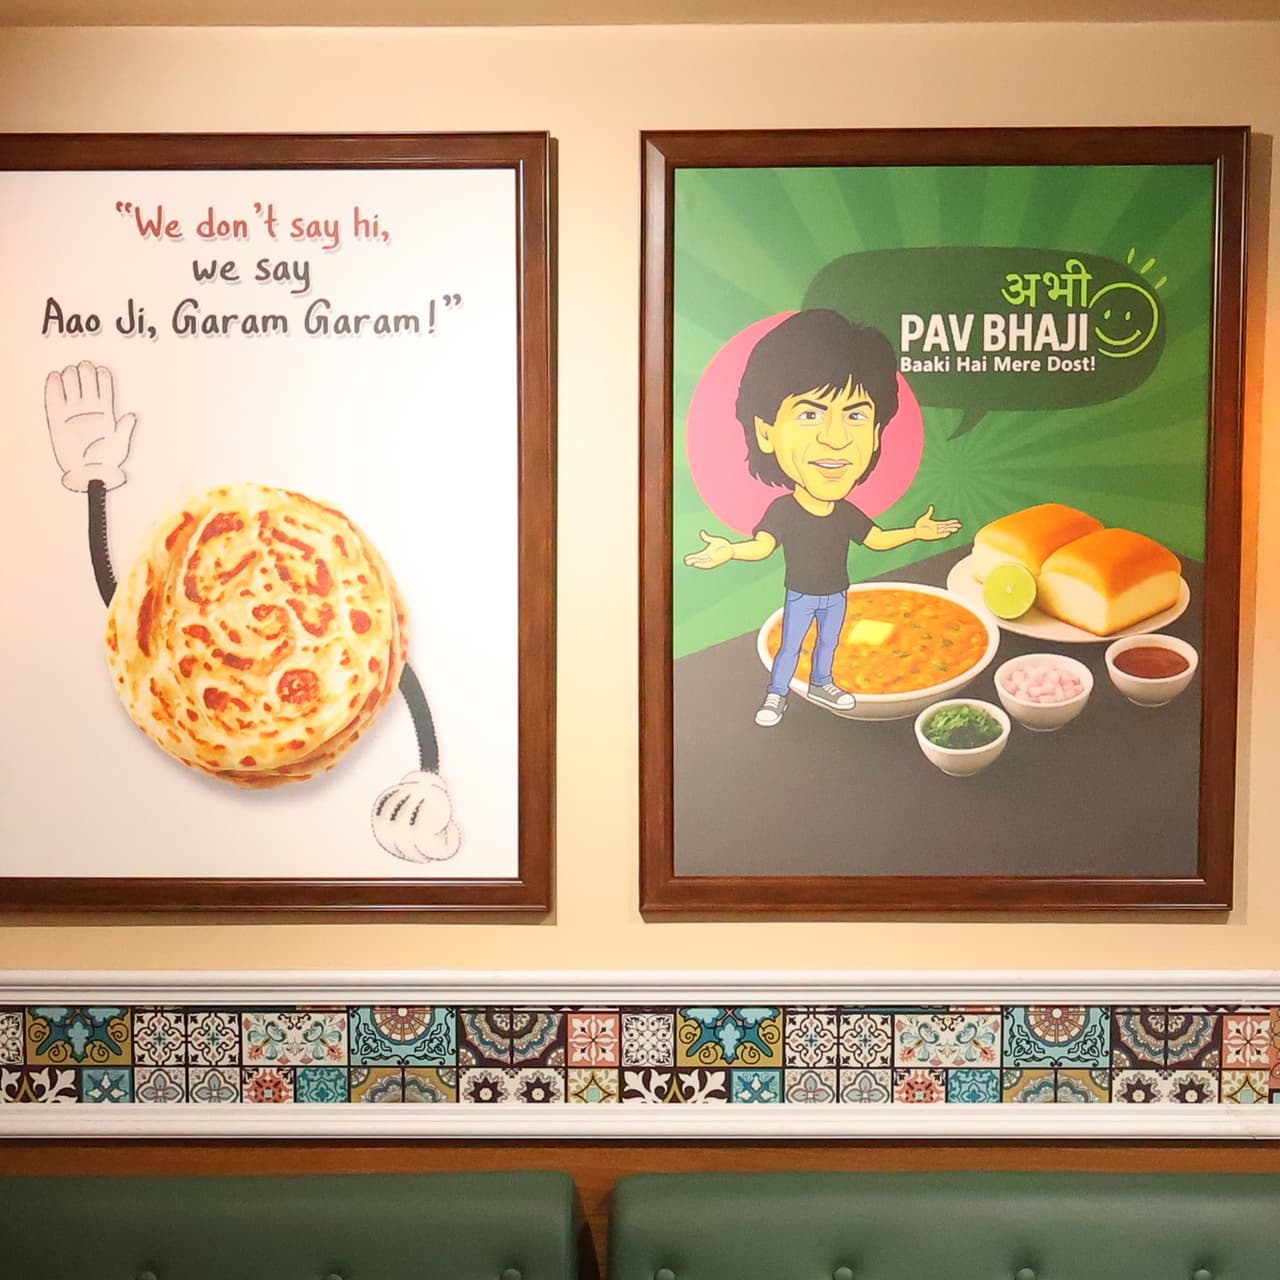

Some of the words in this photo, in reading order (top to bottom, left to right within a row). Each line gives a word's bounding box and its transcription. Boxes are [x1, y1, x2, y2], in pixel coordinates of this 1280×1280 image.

[116, 201, 182, 238] "We
[197, 202, 278, 239] don't
[290, 217, 339, 249] say
[353, 205, 390, 242] hi,
[192, 258, 240, 281] we
[255, 257, 311, 293] say
[1001, 258, 1093, 308] अभी
[42, 297, 100, 334] Aao
[116, 298, 157, 338] Ji,
[172, 298, 288, 334] Garam
[900, 313, 974, 352] PAV
[983, 313, 1088, 352] BHAJI
[900, 356, 950, 372] Baaki
[957, 356, 987, 372] Hai
[994, 357, 1041, 372] Mere
[1047, 356, 1096, 372] Dost!
